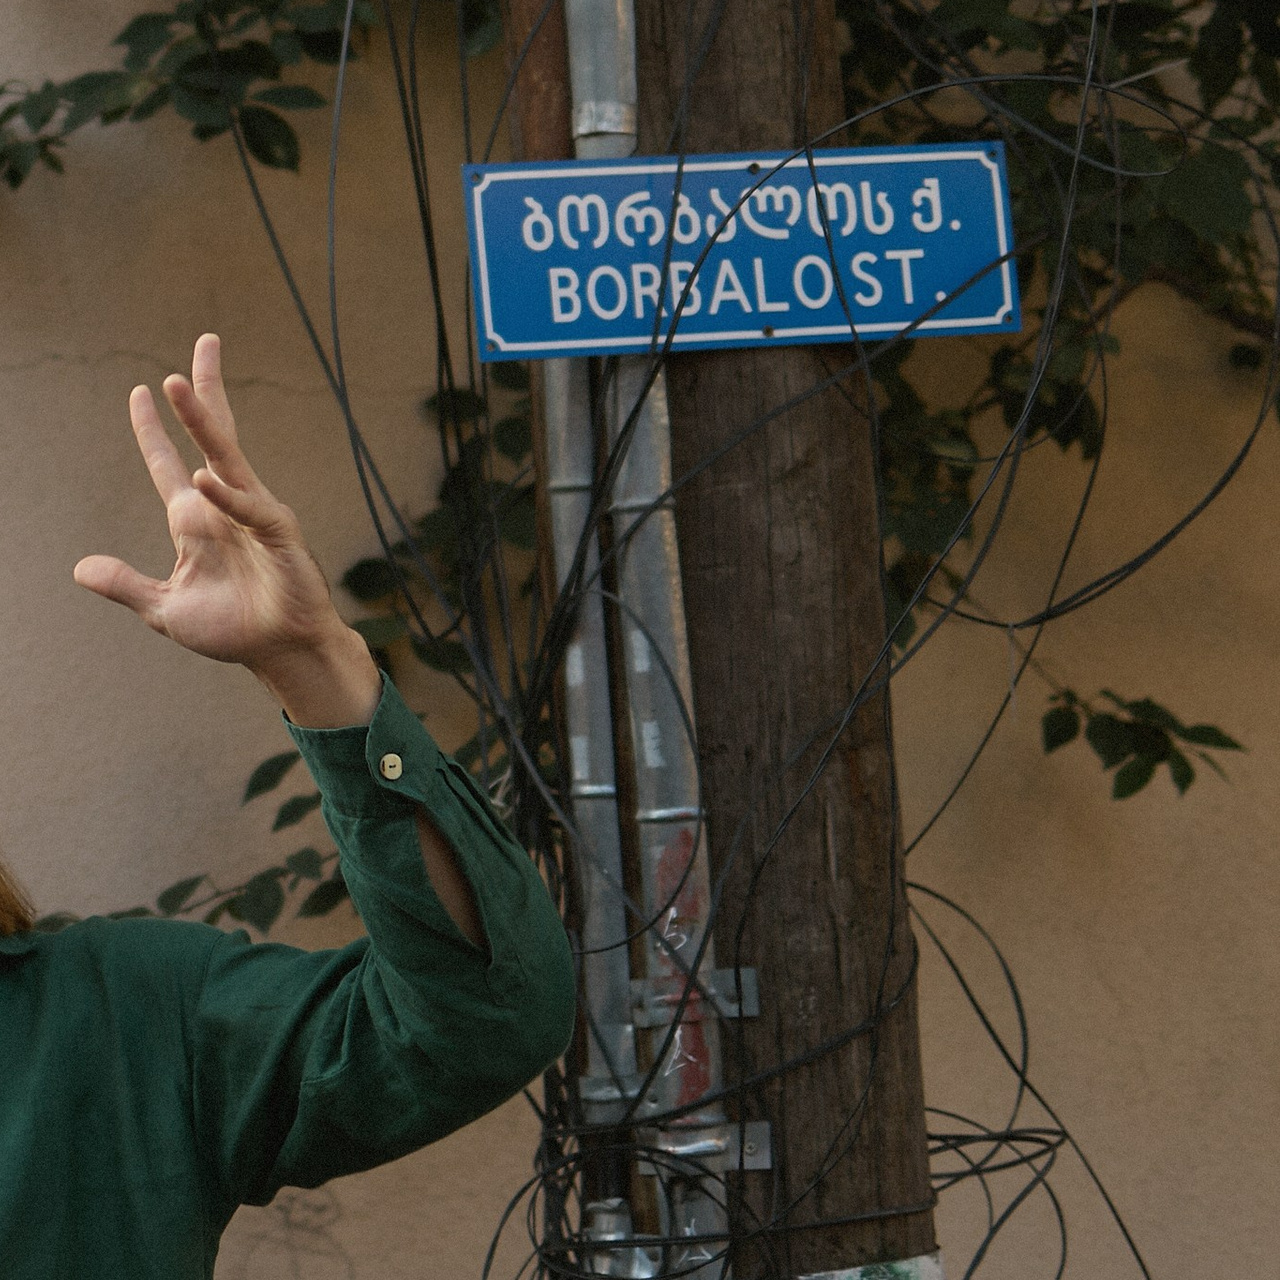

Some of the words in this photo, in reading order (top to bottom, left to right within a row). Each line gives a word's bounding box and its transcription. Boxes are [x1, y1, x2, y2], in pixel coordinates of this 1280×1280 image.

[522, 181, 895, 252] ბორბალოს
[911, 178, 963, 233] ქ.
[549, 255, 835, 324] BORBALO
[851, 249, 949, 308] ST.
